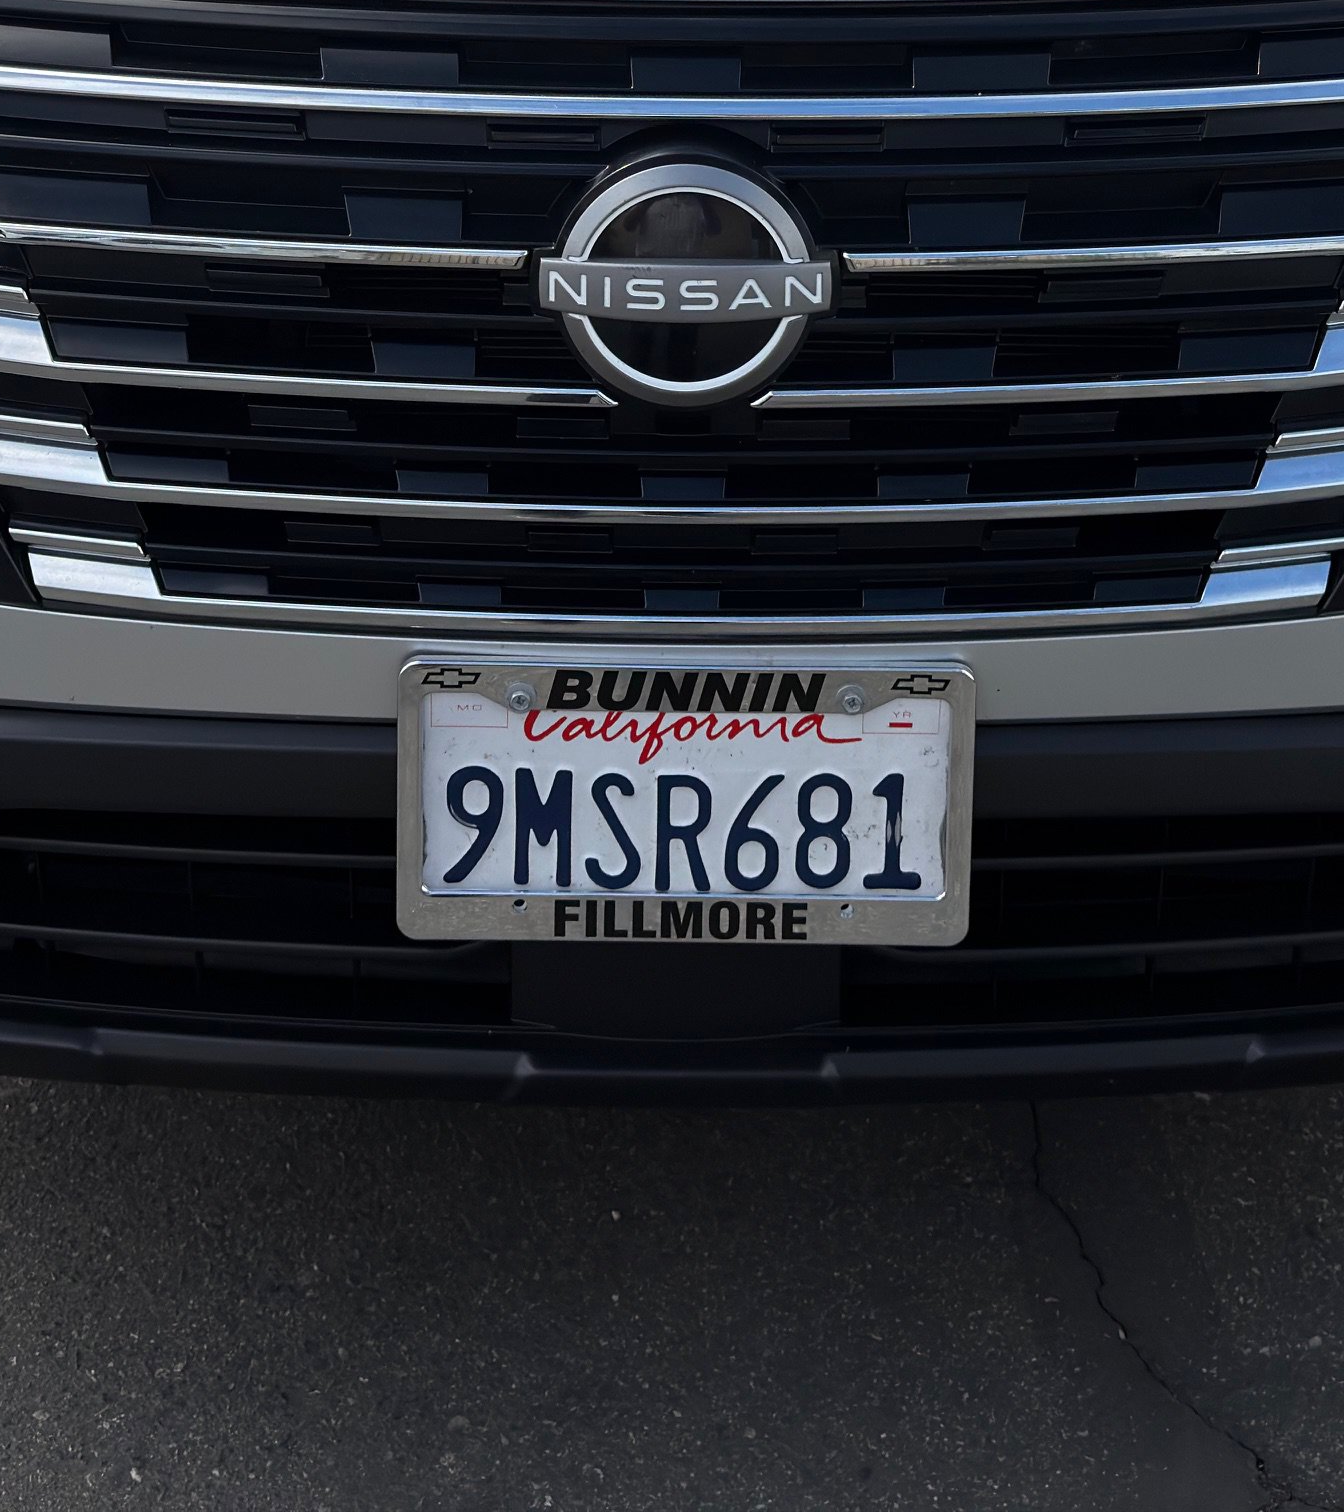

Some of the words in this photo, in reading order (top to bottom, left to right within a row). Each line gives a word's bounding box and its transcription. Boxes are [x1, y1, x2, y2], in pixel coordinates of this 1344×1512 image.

[549, 271, 824, 311] NISSAN
[546, 670, 827, 713] BUNNIN
[523, 709, 862, 765] California
[442, 765, 923, 892] 9MSR681
[554, 900, 809, 941] FILLMORE
